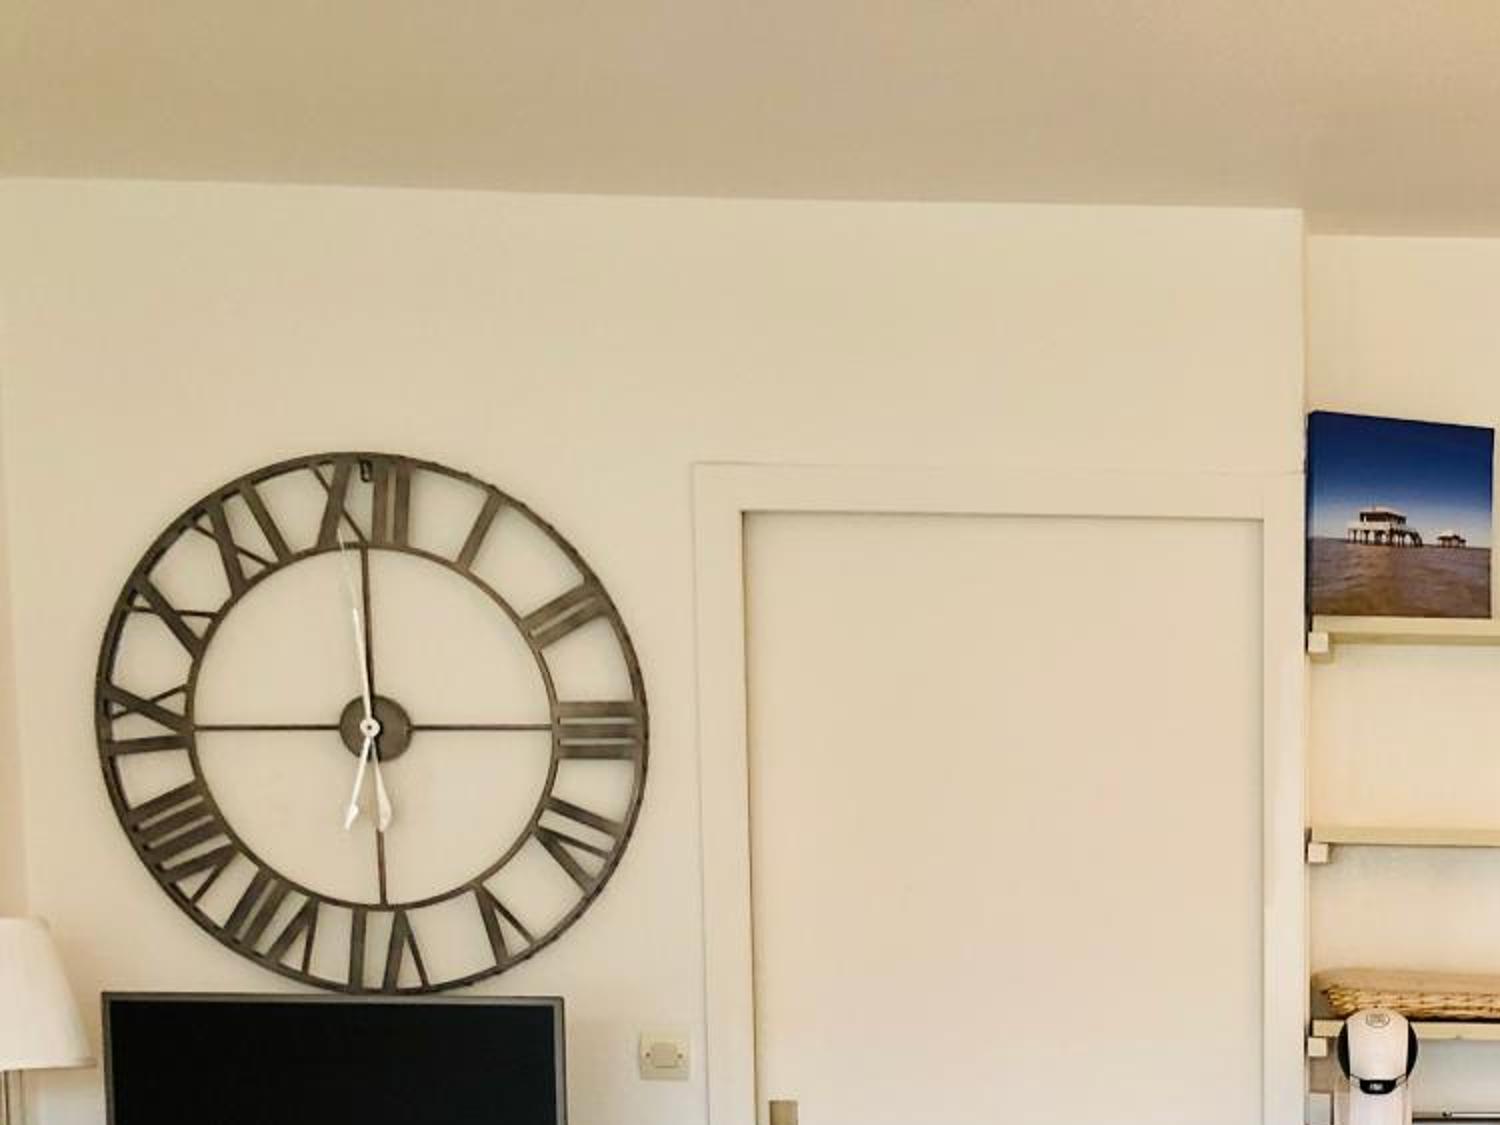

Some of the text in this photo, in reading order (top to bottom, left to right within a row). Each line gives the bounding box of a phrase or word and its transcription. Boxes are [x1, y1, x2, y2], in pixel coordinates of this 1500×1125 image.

[190, 482, 293, 596] XI
[310, 460, 411, 546] XII
[125, 575, 221, 660] X
[521, 578, 612, 650] II
[101, 683, 195, 754] IX
[556, 700, 640, 760] III
[127, 779, 239, 906] VIII
[535, 797, 624, 899] IV
[223, 866, 319, 976] VII
[348, 908, 432, 990] VI
[473, 882, 535, 967] V
